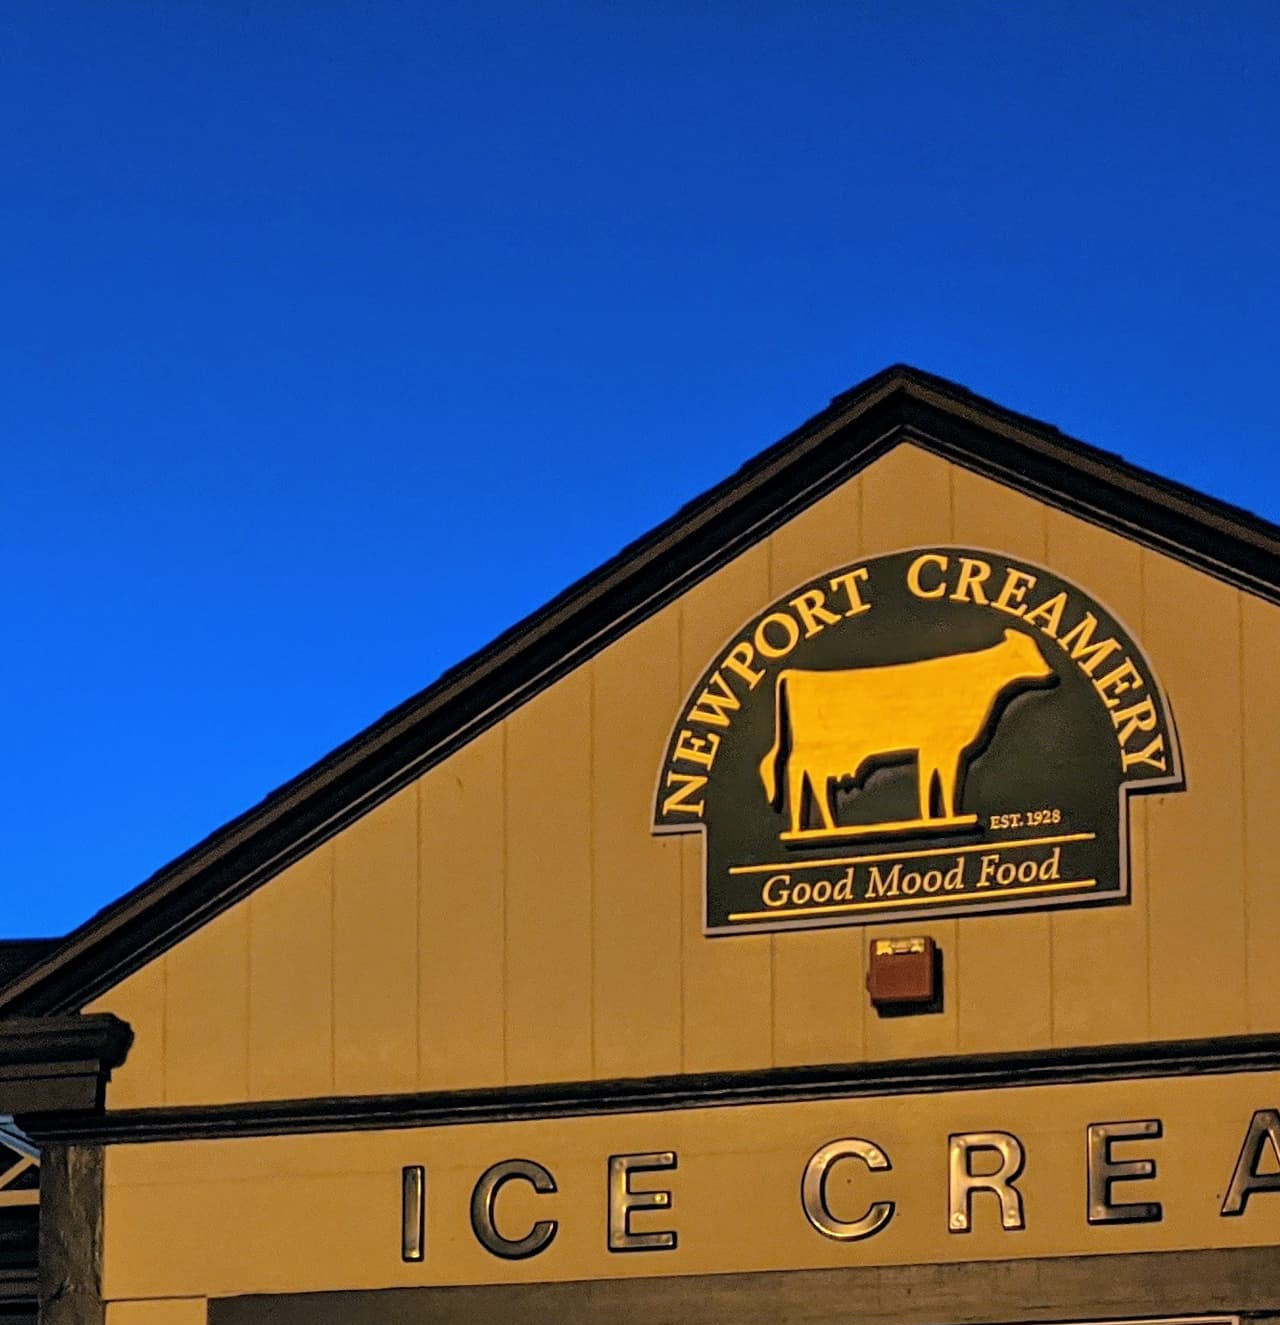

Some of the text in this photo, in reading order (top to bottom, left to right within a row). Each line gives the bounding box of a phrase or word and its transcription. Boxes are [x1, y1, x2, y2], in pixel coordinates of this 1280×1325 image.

[663, 554, 1167, 818] NEWPORT CREAMERY
[990, 808, 1061, 830] EST. 1928
[762, 846, 1062, 907] Good Mood Food
[401, 1151, 678, 1263] ICE
